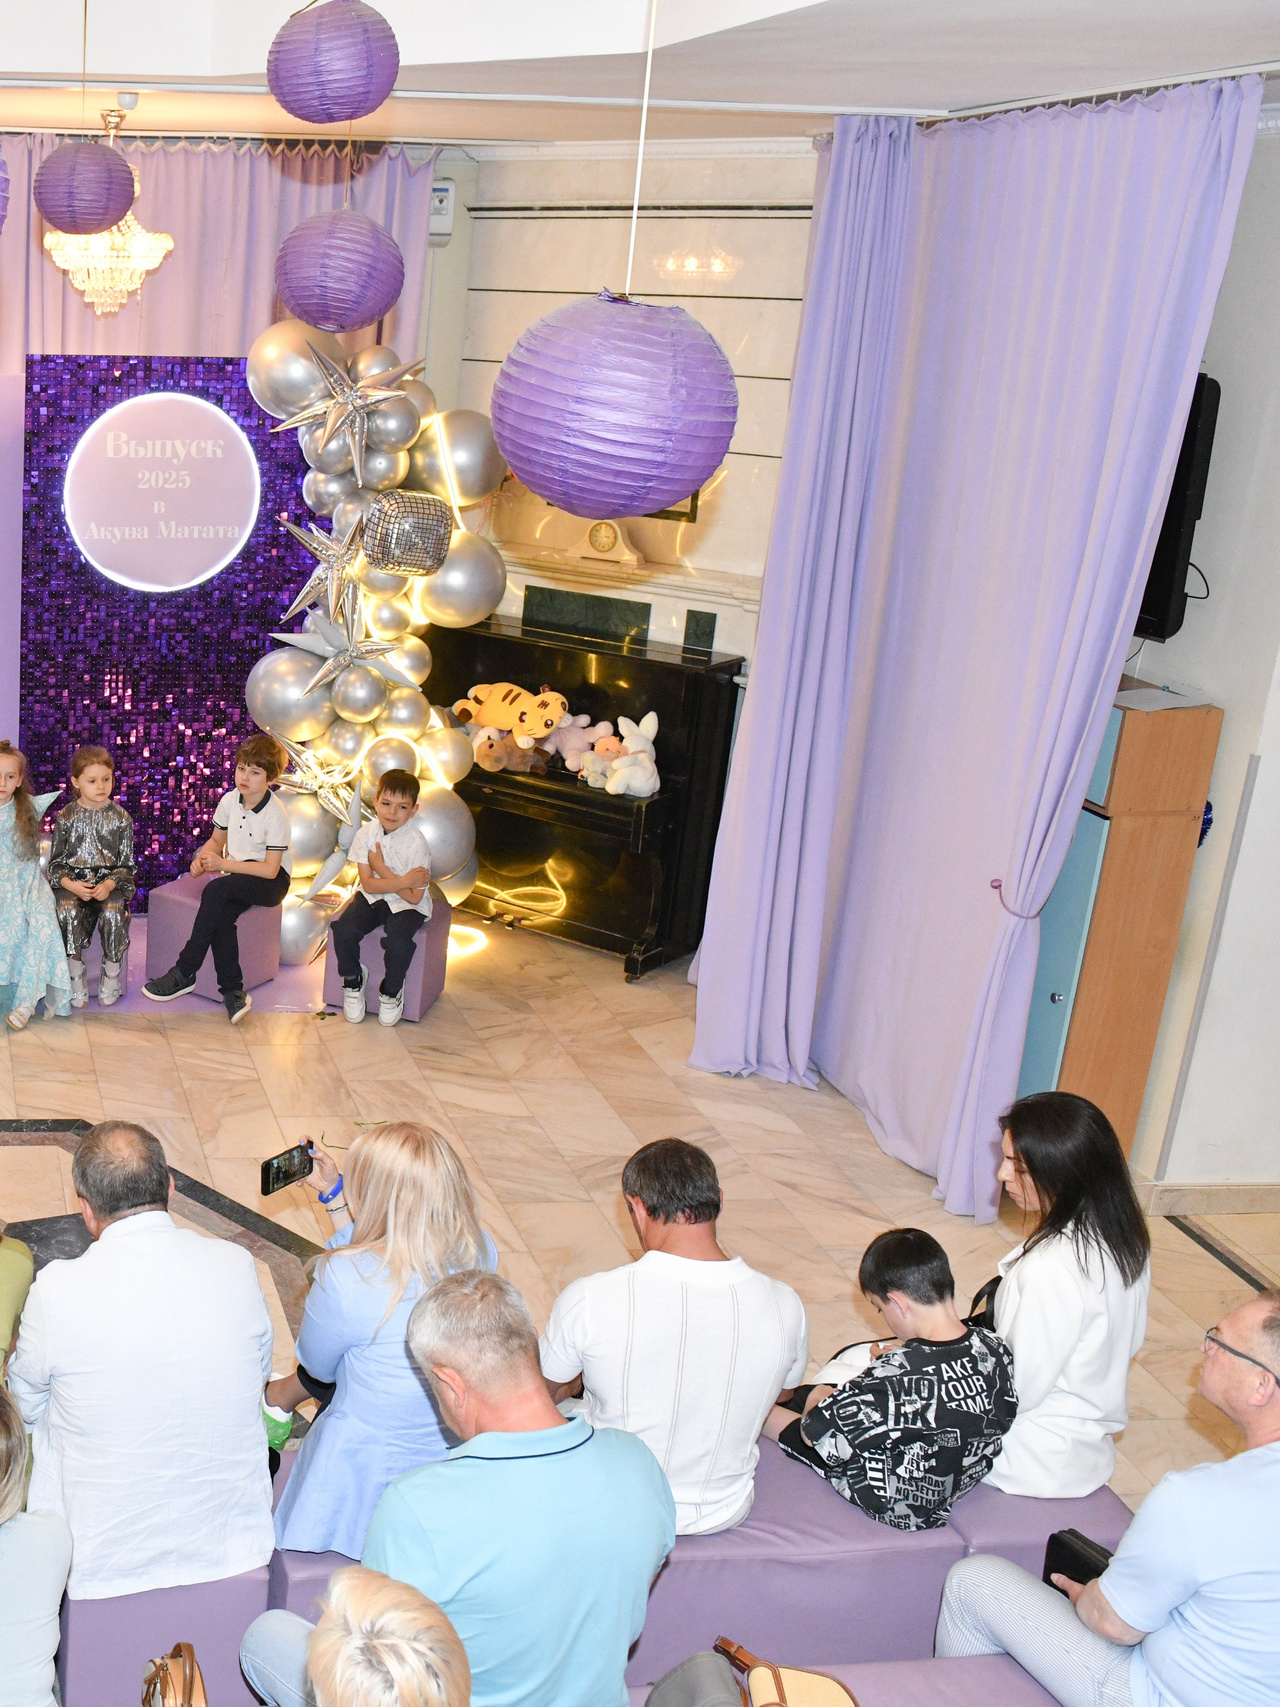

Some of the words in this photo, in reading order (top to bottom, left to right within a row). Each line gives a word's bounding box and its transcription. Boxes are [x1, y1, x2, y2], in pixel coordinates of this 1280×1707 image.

[105, 431, 224, 465] Выпуск
[137, 470, 191, 489] 2025
[153, 501, 165, 514] в
[84, 521, 149, 544] Акуна
[157, 521, 239, 538] Матата
